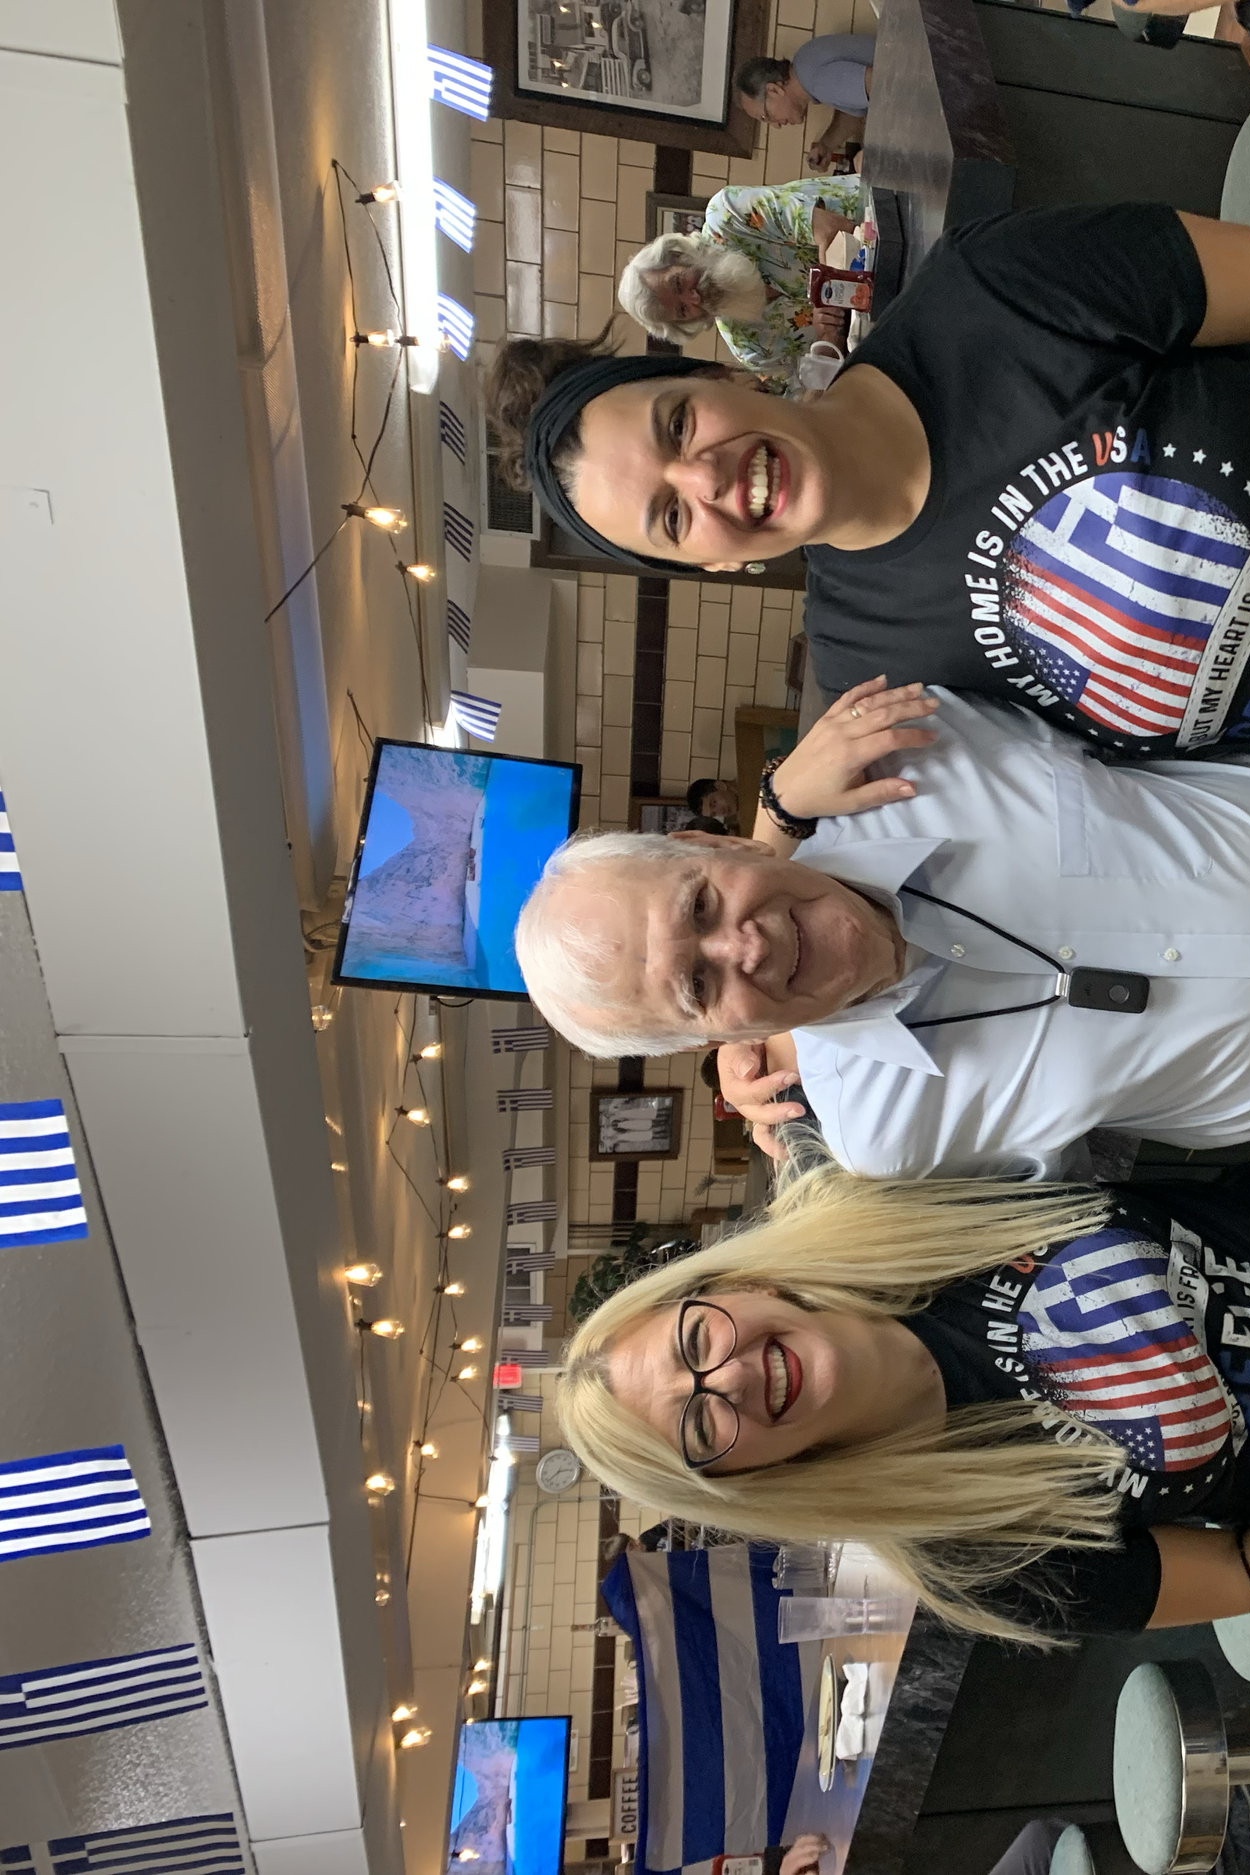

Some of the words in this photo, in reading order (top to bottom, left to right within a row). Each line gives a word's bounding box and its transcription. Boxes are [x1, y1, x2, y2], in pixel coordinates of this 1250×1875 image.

[1092, 425, 1150, 466] USA
[1020, 440, 1088, 496] THE
[991, 484, 1034, 531] IN
[968, 530, 1004, 568] IS
[964, 574, 1020, 668] HOME
[1211, 616, 1250, 681] HEART
[1006, 674, 1060, 706] MY
[1199, 686, 1224, 714] MY
[1188, 718, 1214, 742] BUT
[1176, 1291, 1196, 1310] IS
[986, 1320, 1018, 1353] IN
[994, 1356, 1030, 1382] IS
[1097, 1463, 1149, 1498] MY
[621, 1776, 637, 1833] COFFEE
